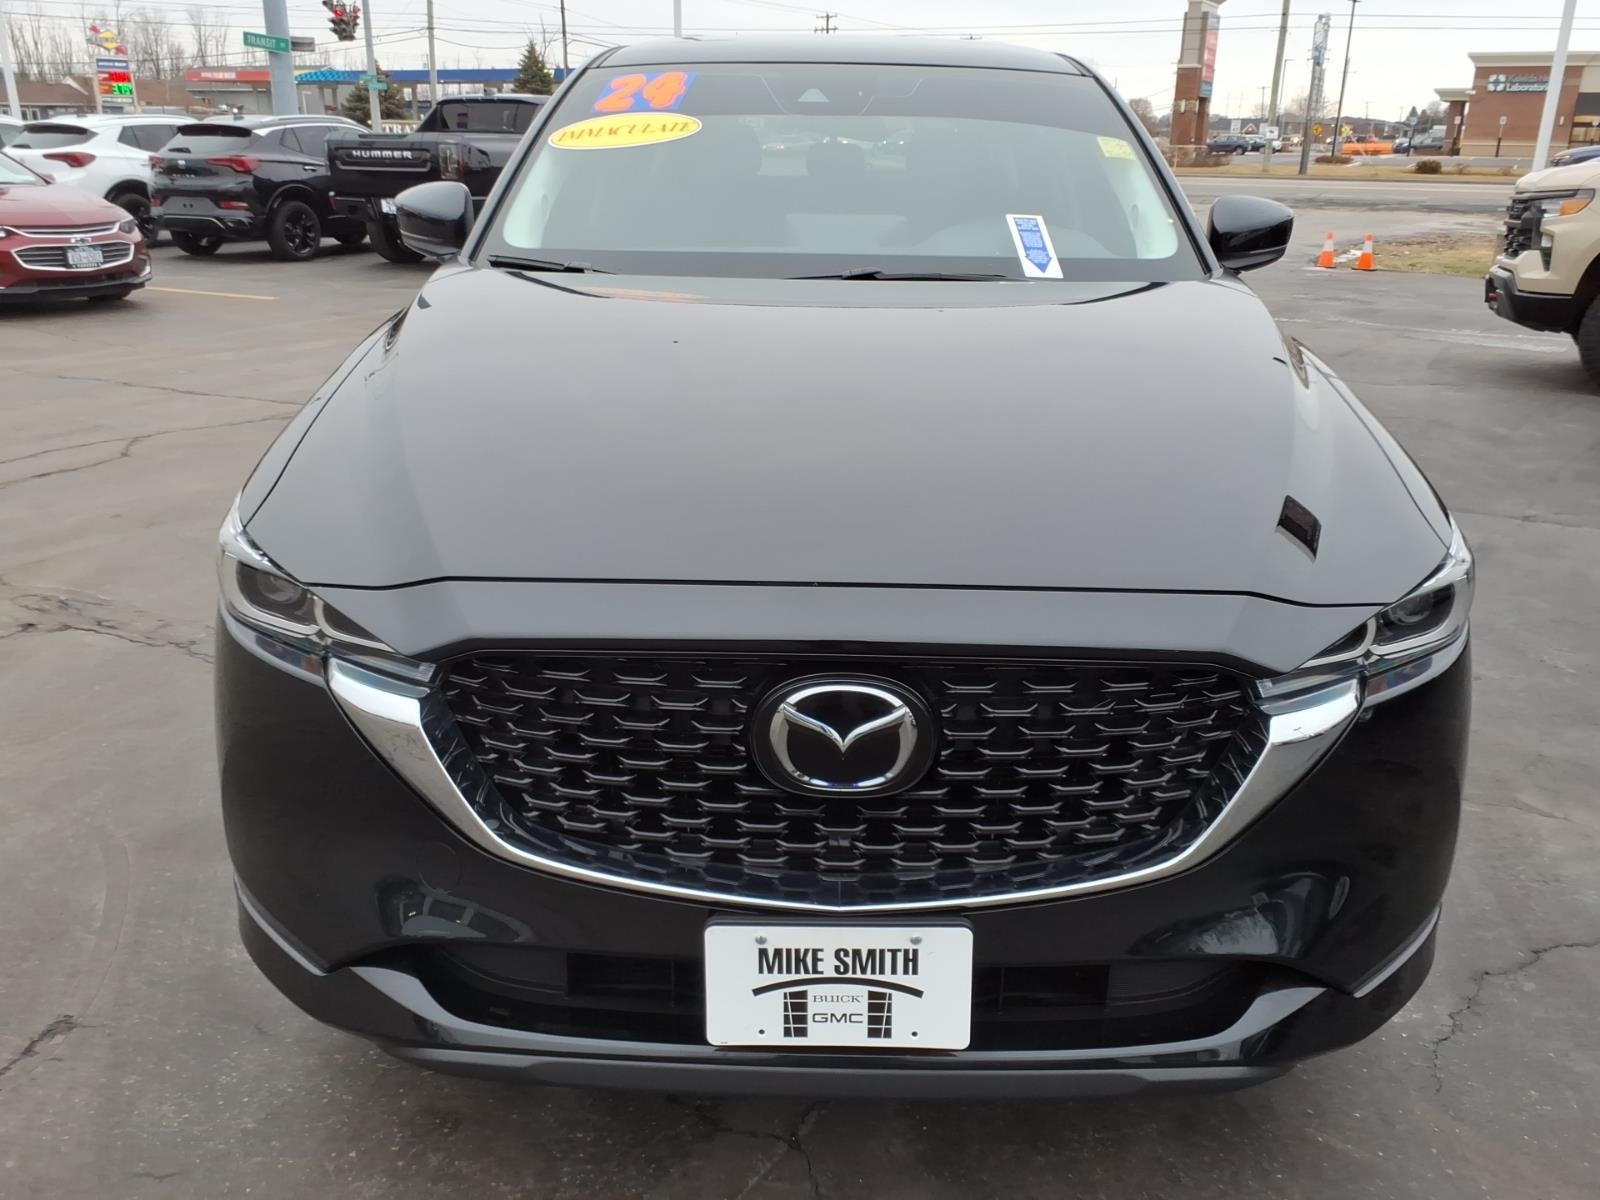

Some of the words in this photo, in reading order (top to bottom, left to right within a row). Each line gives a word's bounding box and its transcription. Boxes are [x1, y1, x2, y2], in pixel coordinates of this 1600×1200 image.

[246, 34, 276, 49] TRANSIT
[594, 71, 688, 112] 24
[352, 149, 412, 159] HUMMER
[758, 947, 824, 975] MIKE
[833, 948, 919, 976] SMITH
[813, 994, 863, 1004] BUICK
[812, 1012, 863, 1024] GMC
